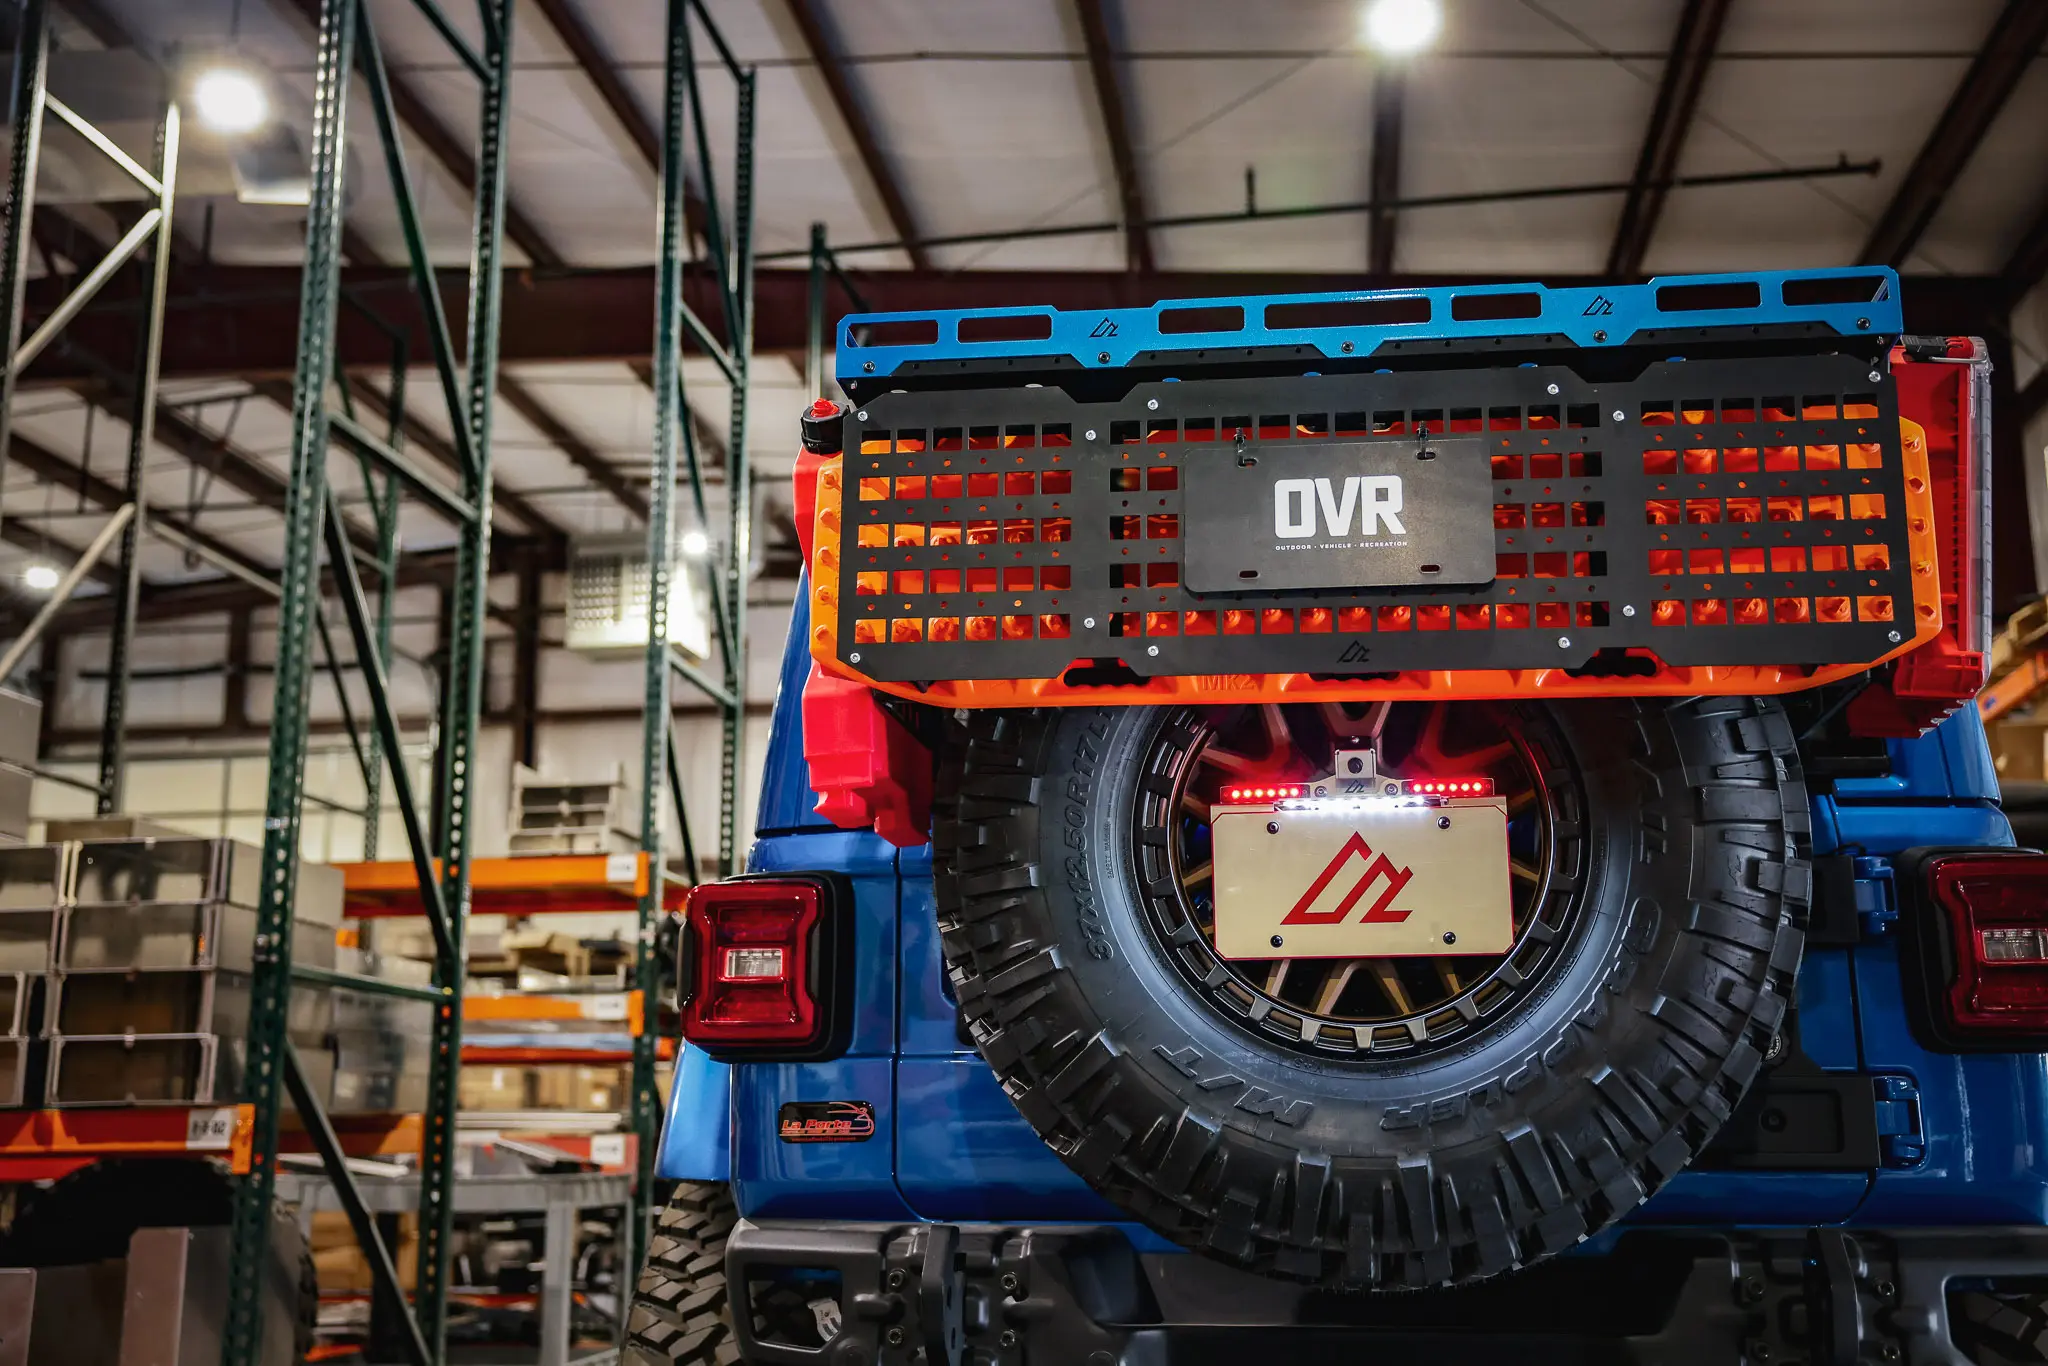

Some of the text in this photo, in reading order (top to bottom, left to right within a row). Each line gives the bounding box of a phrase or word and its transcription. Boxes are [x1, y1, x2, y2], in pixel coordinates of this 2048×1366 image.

[1274, 475, 1406, 538] OVR
[1275, 543, 1311, 551] OUTDOOR
[1359, 540, 1408, 548] RECREATION
[1379, 897, 1663, 1130] GRAPPLER
[1152, 1044, 1314, 1127] M/T
[782, 1119, 802, 1129] La
